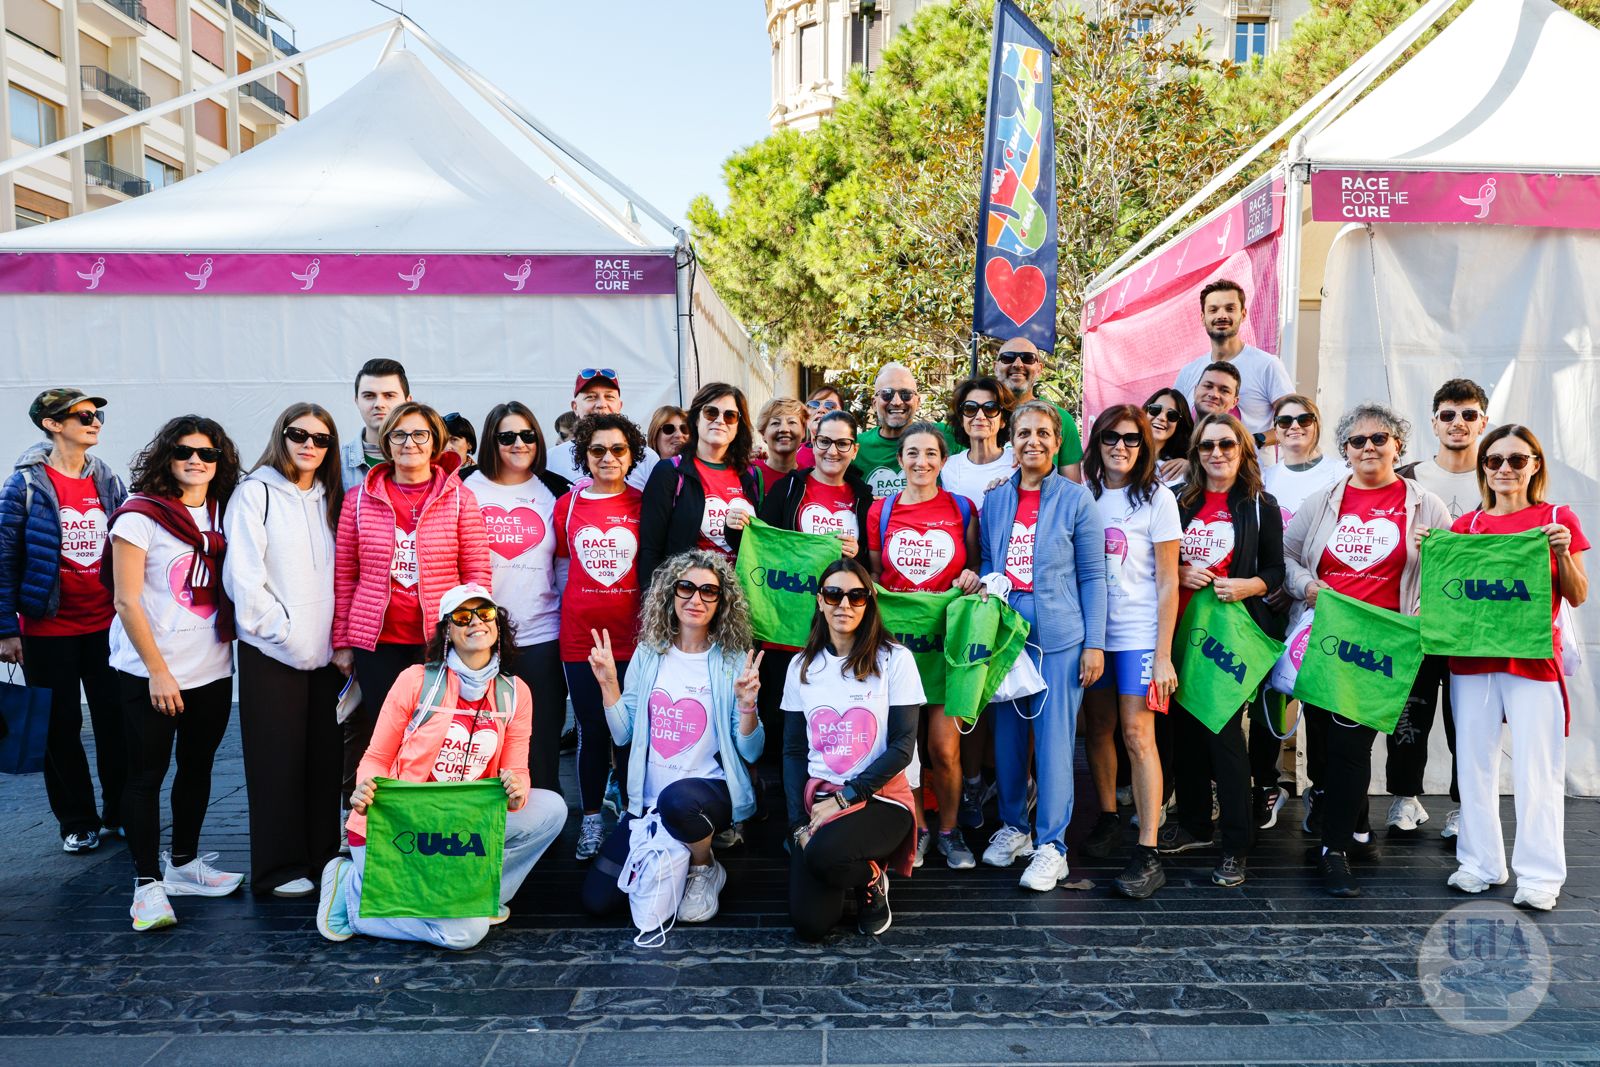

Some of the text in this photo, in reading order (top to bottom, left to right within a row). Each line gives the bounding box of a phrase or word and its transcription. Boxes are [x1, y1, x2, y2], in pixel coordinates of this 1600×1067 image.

[1341, 176, 1390, 190] RACE
[1249, 192, 1267, 213] RACE
[1342, 191, 1409, 204] FOR THE
[1249, 202, 1272, 226] FOR THE
[1342, 205, 1390, 218] CURE
[1247, 222, 1264, 240] CURE
[595, 259, 630, 269] RACE
[595, 270, 643, 280] FOR THE
[595, 281, 630, 290] CURE
[877, 479, 907, 488] RACE
[708, 509, 730, 518] RA
[61, 520, 96, 530] RACE
[485, 516, 522, 525] RACE
[710, 519, 725, 527] FO
[812, 515, 843, 527] RACE
[486, 524, 538, 535] FOR THE
[1338, 525, 1375, 535] RACE
[487, 534, 523, 544] CURE
[582, 539, 616, 548] RACE
[899, 537, 933, 547] RACE
[1181, 536, 1227, 548] OR THE
[1337, 534, 1389, 545] FOR THE
[61, 541, 97, 551] CURE
[395, 540, 416, 550] CE
[1335, 544, 1372, 554] CURE
[584, 549, 629, 558] FOR THE
[898, 547, 946, 558] FOR THE
[1180, 546, 1210, 557] CURE
[391, 561, 417, 572] URE
[585, 560, 617, 569] CURE
[897, 557, 931, 567] CURE
[652, 704, 683, 720] RACE
[674, 720, 696, 733] THE
[818, 721, 853, 734] RACE
[820, 732, 868, 744] FOR THE
[441, 738, 480, 753] RACE
[824, 745, 853, 756] CURE
[438, 750, 489, 765] FOR THE
[435, 762, 471, 775] CURE
